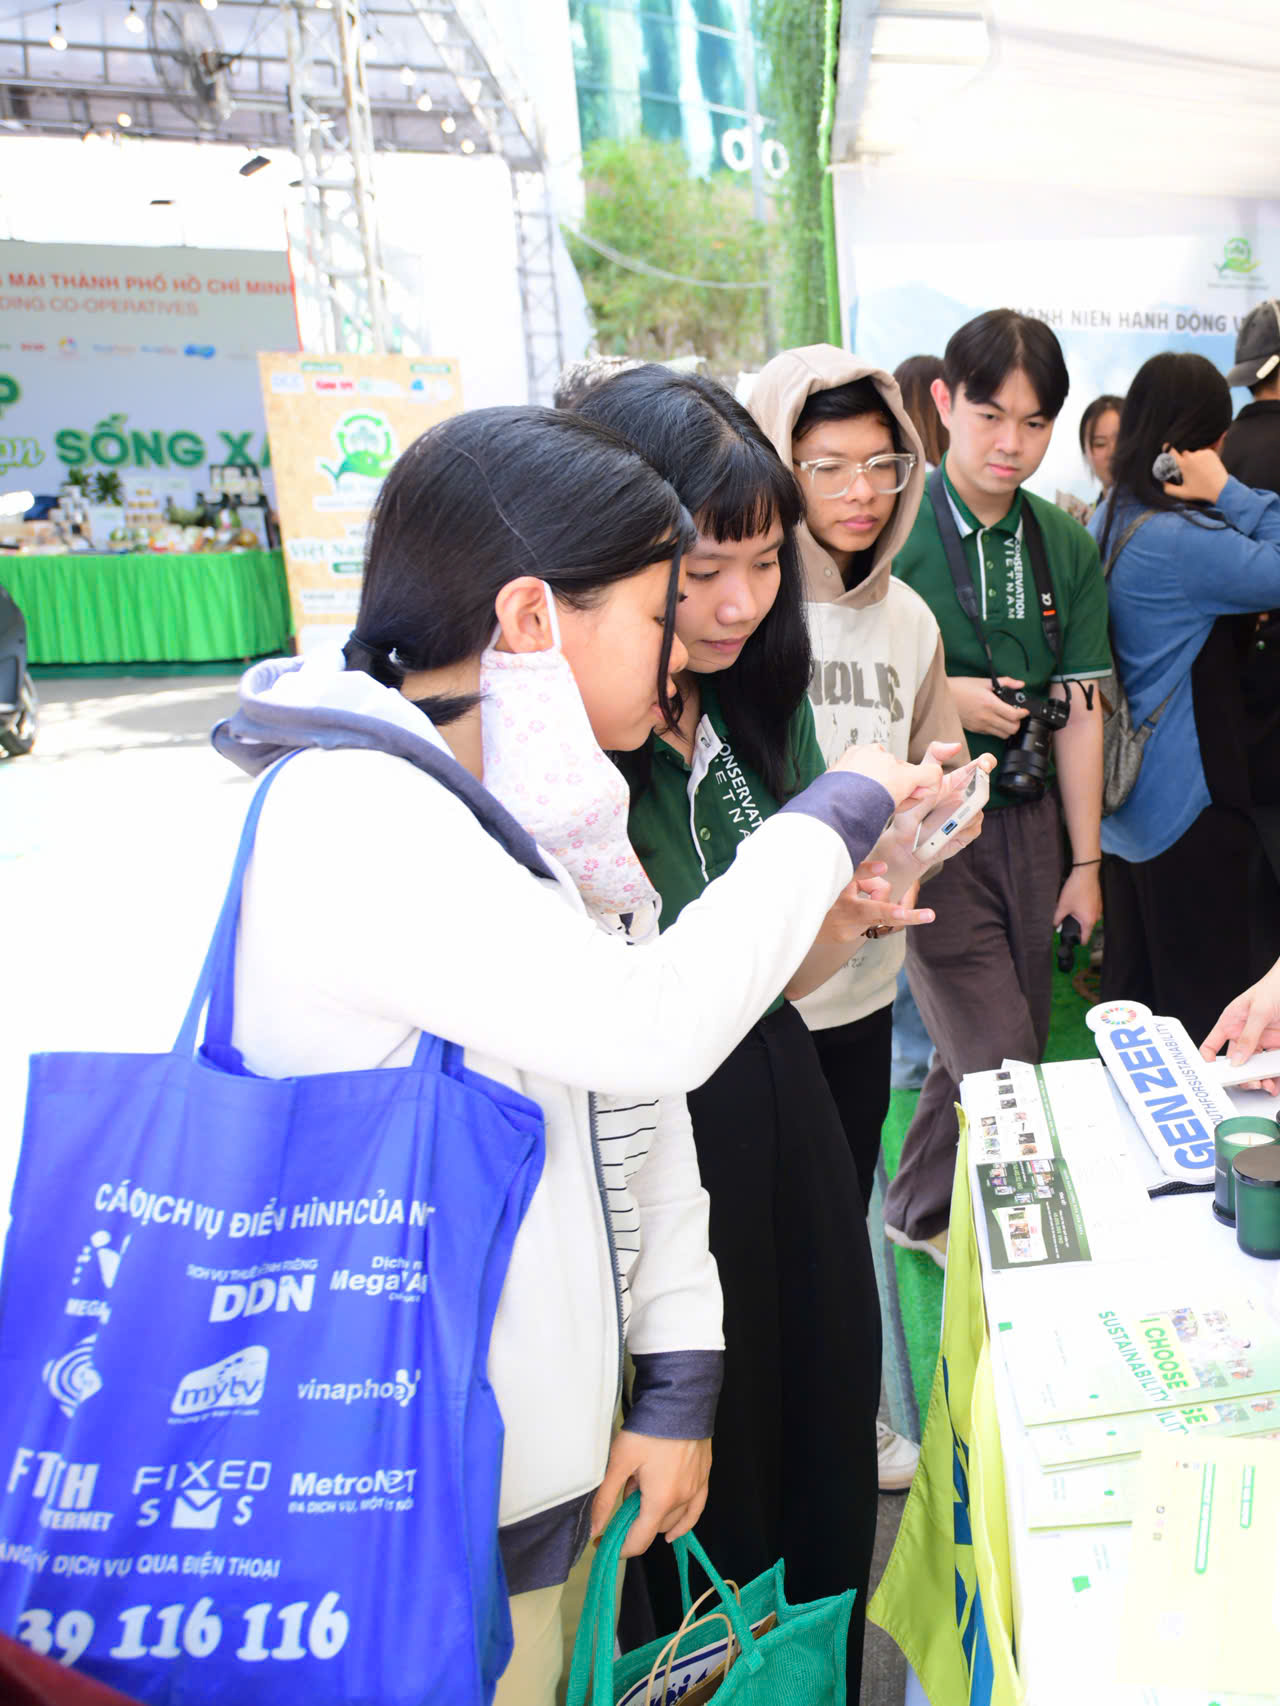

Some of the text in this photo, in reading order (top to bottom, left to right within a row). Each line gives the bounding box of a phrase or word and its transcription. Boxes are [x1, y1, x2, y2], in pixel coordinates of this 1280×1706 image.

[55, 412, 208, 468] SỐNG
[1003, 537, 1016, 620] VIETNAM
[719, 736, 764, 828] ONSERVAT
[1144, 1093, 1216, 1170] GEN
[194, 1203, 225, 1241] VỤ
[353, 1188, 405, 1226] CỦA
[208, 1273, 317, 1323] DDN
[1098, 1310, 1173, 1403] SUSTAINABILITY
[1144, 1327, 1190, 1390] CHOOSE
[180, 1374, 261, 1407] mytv
[132, 1459, 272, 1495] FIXED
[52, 1555, 101, 1579] DỊCH
[103, 1557, 133, 1579] VỤ
[135, 1553, 179, 1576] QUA
[227, 1556, 282, 1582] THOẠI
[108, 1596, 223, 1660] 116
[236, 1591, 350, 1662] 116
